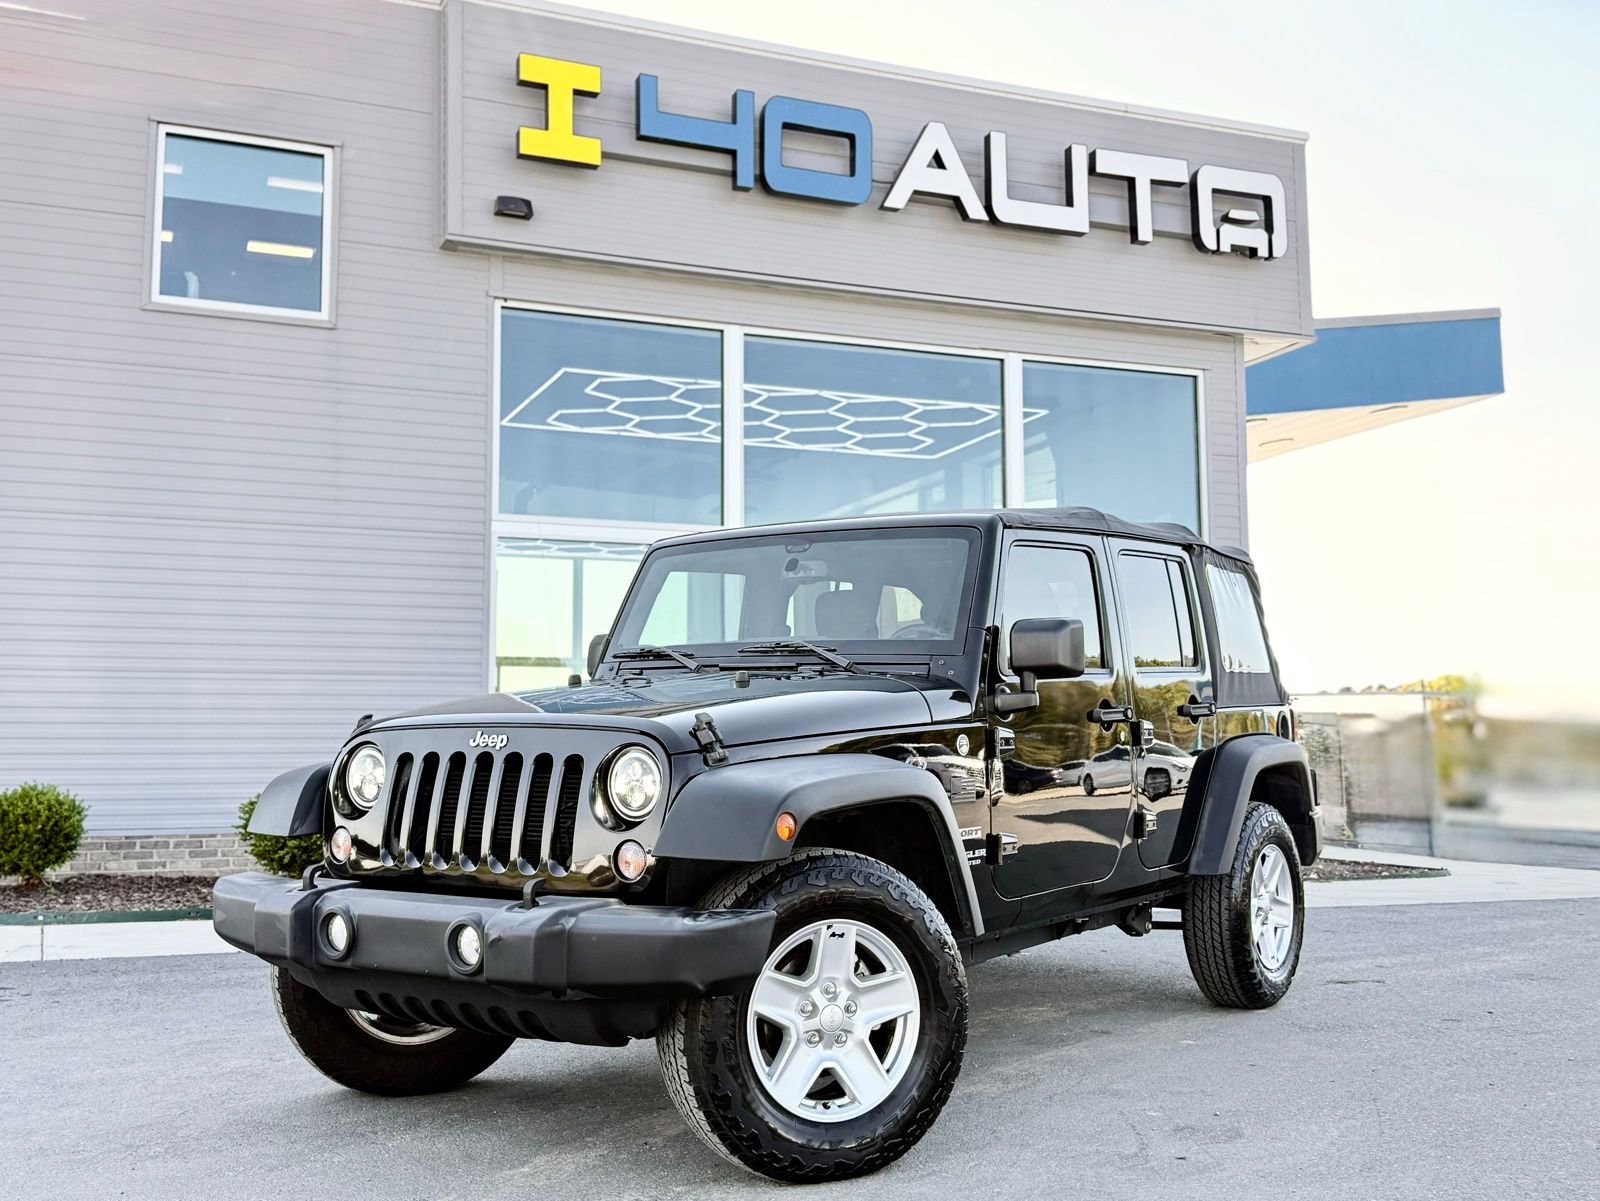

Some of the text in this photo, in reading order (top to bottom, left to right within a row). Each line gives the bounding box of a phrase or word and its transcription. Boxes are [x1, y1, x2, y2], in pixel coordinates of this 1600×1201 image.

[516, 52, 602, 170] I
[635, 72, 873, 207] 40
[469, 730, 509, 751] Jeep
[960, 829, 979, 838] ORT
[965, 848, 987, 858] GLER
